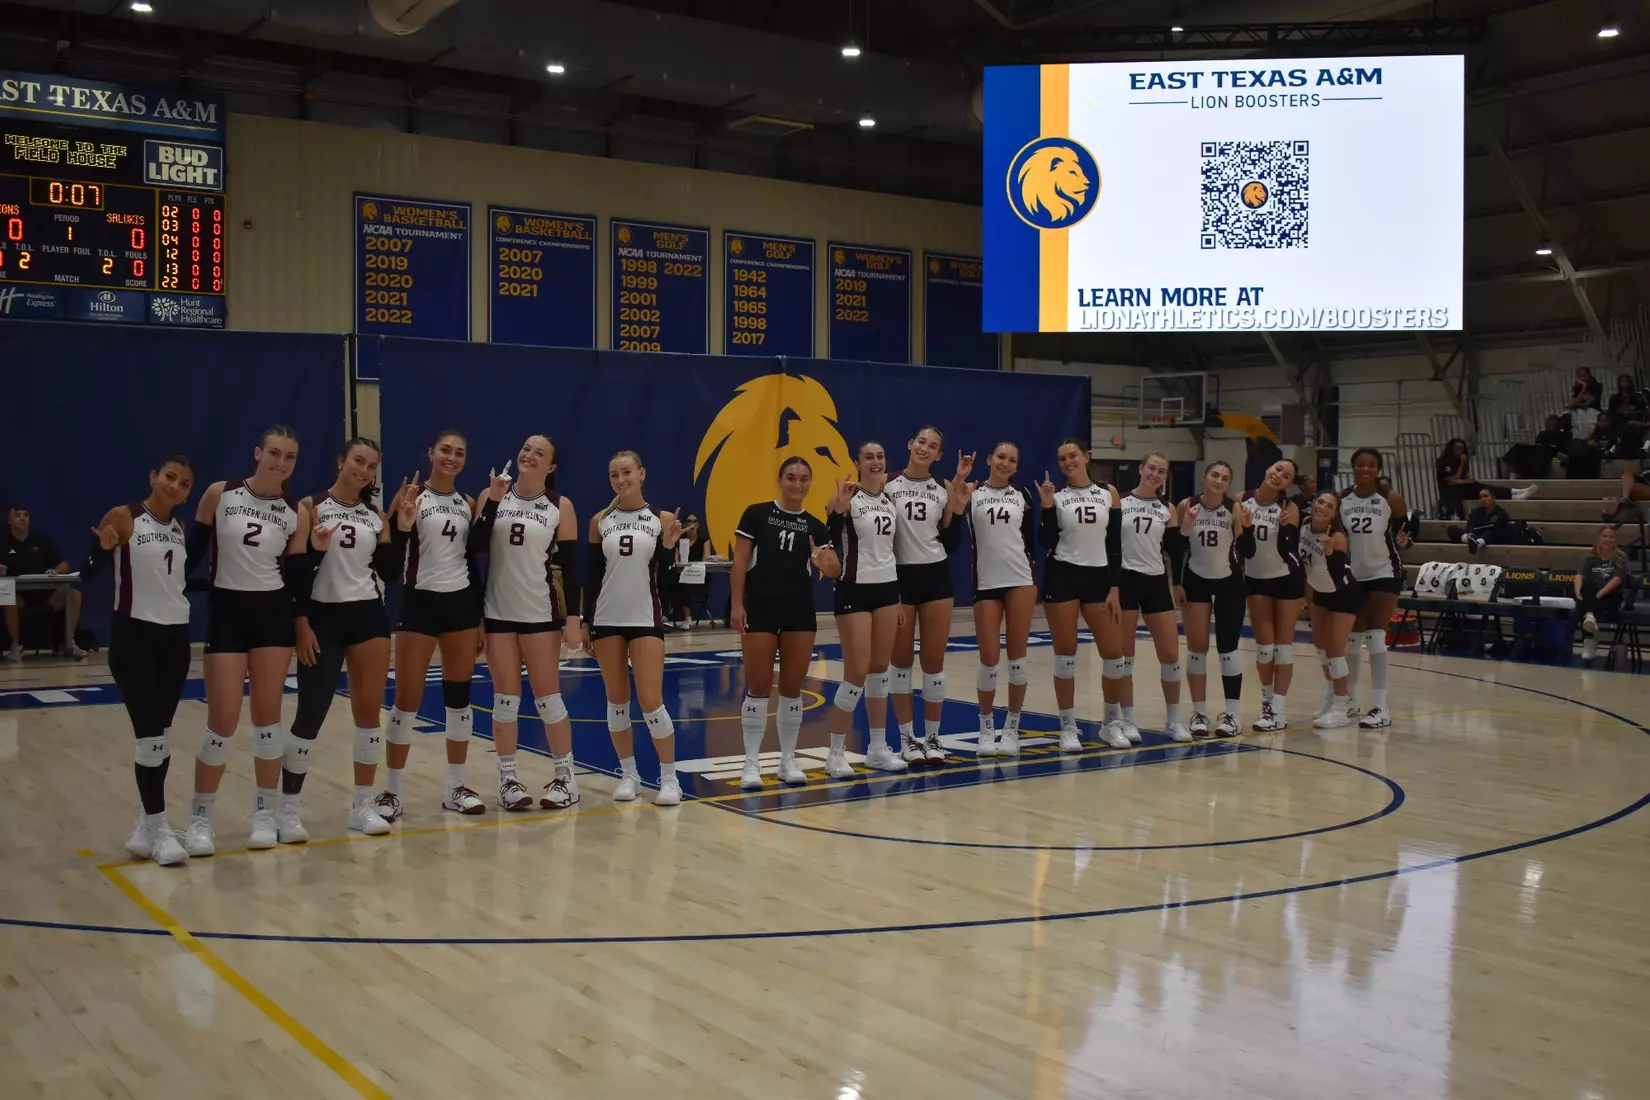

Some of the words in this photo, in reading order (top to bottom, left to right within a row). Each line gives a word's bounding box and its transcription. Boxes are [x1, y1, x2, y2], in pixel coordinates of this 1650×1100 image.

[1129, 72, 1204, 90] EAST
[1212, 69, 1308, 88] TEXAS
[1316, 67, 1383, 86] A&M
[0, 79, 41, 104] ST
[47, 85, 147, 116] TEXAS
[152, 97, 218, 124] A&M
[1191, 96, 1228, 109] LION
[1235, 93, 1320, 108] BOOSTERS
[4, 134, 69, 150] WELCOME
[75, 141, 94, 153] TO
[100, 143, 127, 156] THE
[14, 146, 60, 164] FIELD
[66, 151, 117, 170] HOUSE
[158, 145, 209, 166] BUD
[148, 162, 218, 185] LIGHT
[50, 182, 99, 206] 0:07
[54, 213, 80, 223] PERIOD
[106, 212, 145, 226] SALUKIS
[162, 205, 179, 218] 02
[192, 207, 200, 220] 0
[213, 209, 221, 222] 0
[392, 206, 458, 220] WOMEN'S
[162, 219, 179, 232] 03
[192, 221, 200, 234] 0
[383, 213, 467, 230] BASKETBALL
[523, 217, 584, 231] WOMEN'S
[9, 218, 24, 241] 0
[68, 226, 73, 241] 1
[213, 223, 221, 236] 0
[363, 223, 393, 236] NCAA
[395, 227, 463, 240] TOURNAMENT
[515, 224, 593, 241] BASKETBALL
[653, 231, 690, 243] MEN'S
[131, 227, 145, 250] 0
[162, 233, 179, 246] 04
[192, 235, 200, 248] 0
[213, 237, 221, 250] 0
[365, 236, 413, 253] 2007
[656, 240, 686, 251] GOLF
[42, 244, 70, 254] PLAYER
[73, 247, 92, 256] FOUL
[166, 248, 179, 261] 12
[618, 247, 643, 258] NCAA
[646, 250, 703, 262] TOURNAMENT
[762, 241, 796, 253] MEN'S
[19, 251, 31, 269] 2
[125, 251, 148, 260] FOULS
[192, 249, 200, 262] 0
[212, 251, 221, 264] 0
[365, 254, 409, 271] 2019
[499, 247, 543, 264] 2007
[765, 250, 793, 260] GOLF
[102, 257, 114, 275] 2
[133, 260, 145, 277] 0
[166, 262, 179, 275] 13
[192, 264, 200, 277] 0
[212, 265, 221, 278] 0
[499, 264, 543, 281] 2020
[621, 258, 657, 274] 1998
[664, 261, 702, 277] 2022
[54, 274, 80, 283] MATCH
[365, 272, 414, 289] 2020
[733, 268, 766, 283] 1942
[834, 268, 856, 278] NCAA
[857, 271, 906, 281] TOURNAMENT
[125, 279, 148, 288] SCORE
[161, 276, 179, 289] 22
[499, 281, 539, 297] 2021
[621, 275, 658, 290] 1999
[835, 278, 867, 292] 2019
[365, 290, 408, 306] 2021
[620, 291, 657, 306] 2001
[733, 284, 767, 299] 1964
[1078, 288, 1151, 307] LEARN
[1161, 287, 1227, 306] MORE
[1236, 287, 1264, 306] AT
[26, 299, 55, 308] Express
[90, 302, 124, 313] Hilton
[180, 298, 201, 307] Hunt
[733, 300, 767, 315] 1965
[835, 293, 866, 307] 2021
[180, 306, 214, 317] Regional
[180, 314, 223, 324] Healthcare
[365, 308, 413, 324] 2022
[620, 307, 660, 323] 2002
[835, 308, 869, 322] 2022
[1079, 306, 1450, 330] LIONATHLETICS.COM/BOOSTERS
[733, 315, 767, 330] 1998
[620, 324, 660, 339] 2007
[732, 331, 765, 345] 2017
[620, 340, 660, 353] 2009
[225, 506, 260, 519] SOUTHERN
[261, 511, 288, 531] ILLINOIS
[904, 502, 926, 521] 13
[987, 507, 1010, 525] 14
[1075, 506, 1097, 524] 15
[442, 520, 457, 541] 4
[874, 516, 892, 535] 12
[1133, 516, 1153, 534] 17
[1351, 516, 1373, 534] 22
[243, 522, 263, 547] 2
[340, 525, 356, 548] 3
[510, 523, 525, 545] 8
[779, 529, 795, 552] 11
[1197, 530, 1218, 547] 18
[619, 535, 633, 556] 9
[164, 549, 173, 575] 1
[1505, 571, 1536, 580] LIONS
